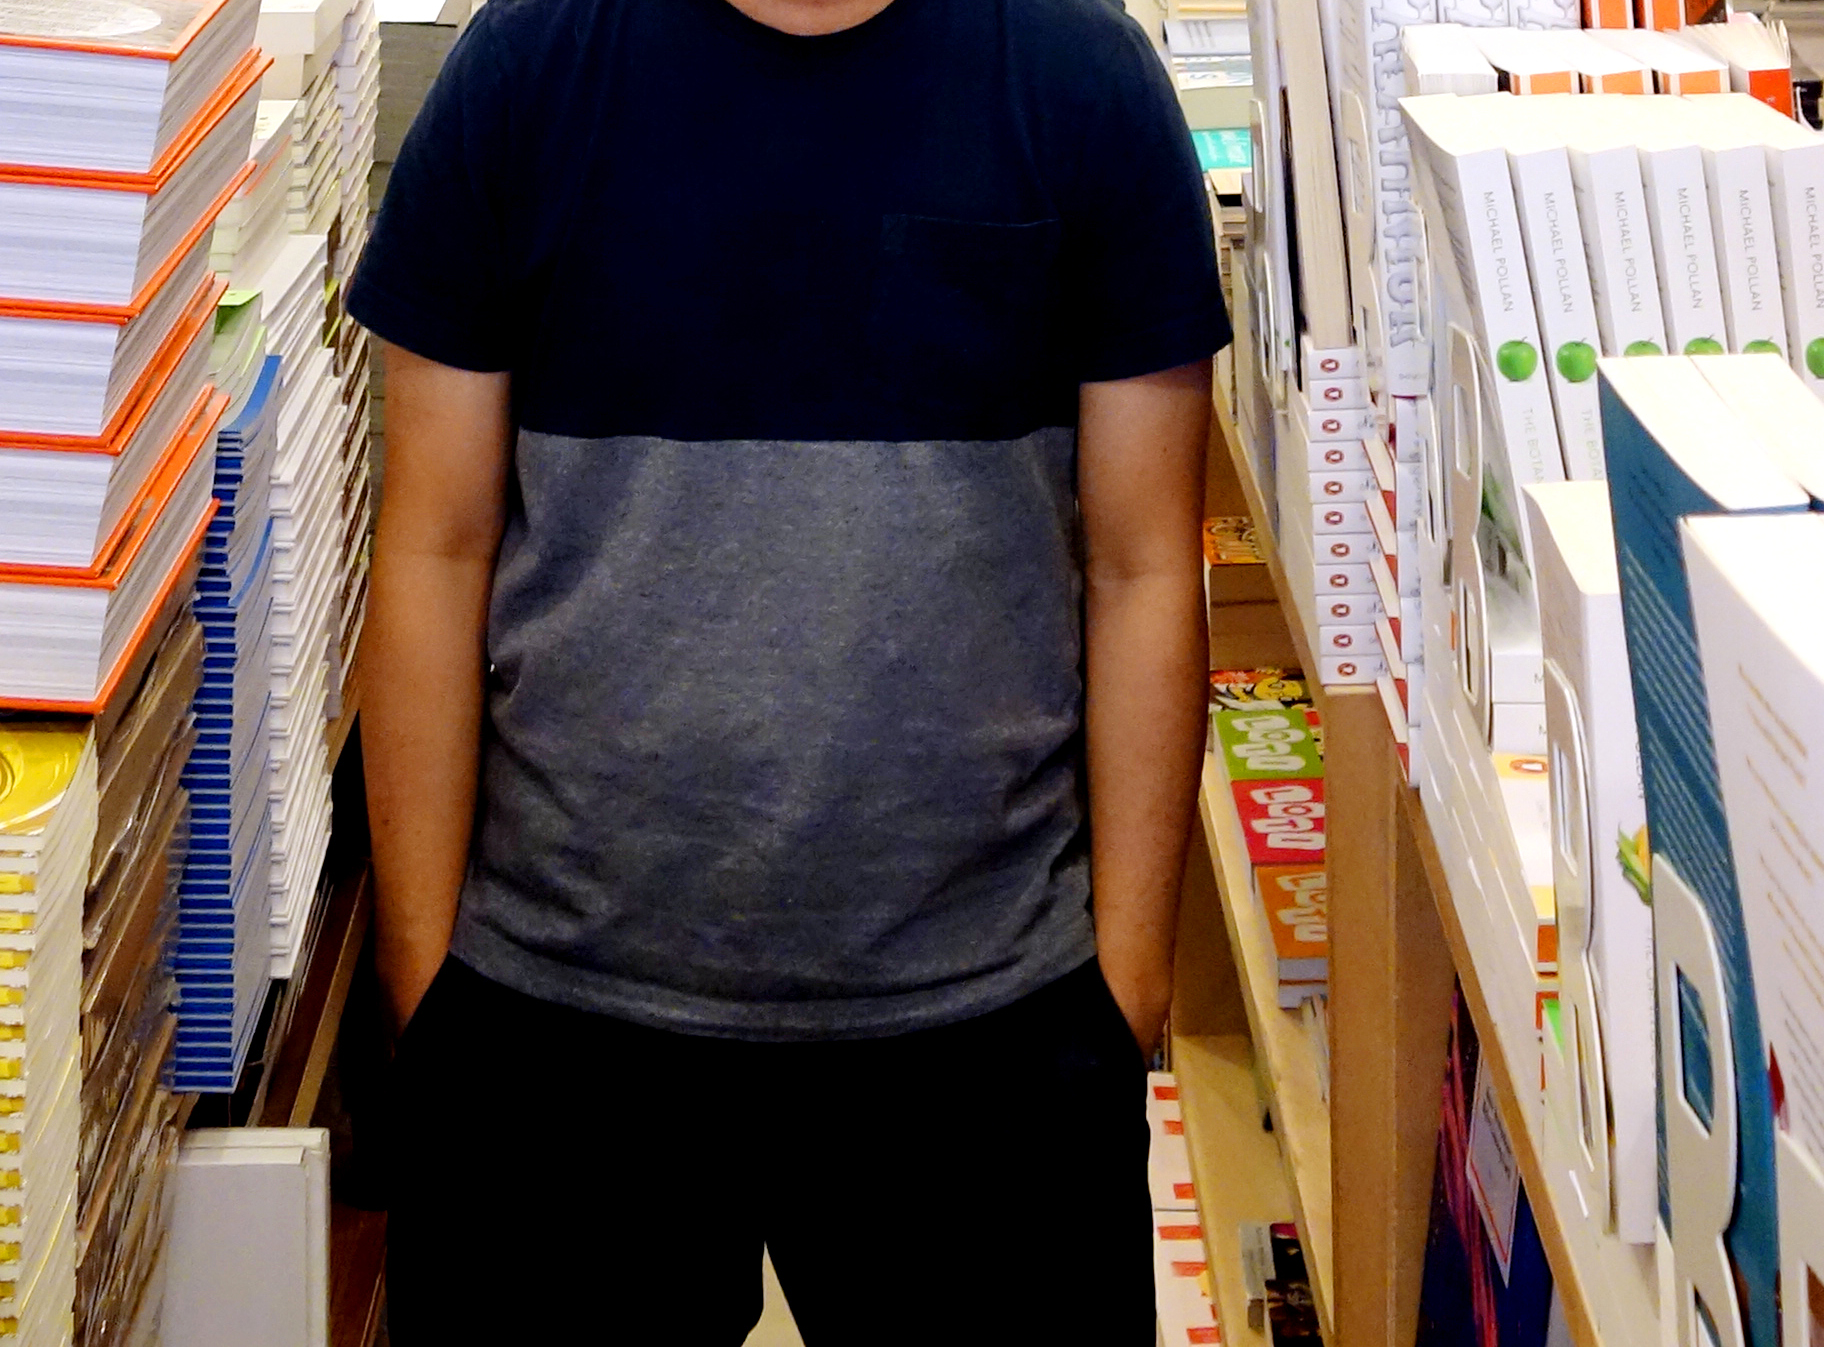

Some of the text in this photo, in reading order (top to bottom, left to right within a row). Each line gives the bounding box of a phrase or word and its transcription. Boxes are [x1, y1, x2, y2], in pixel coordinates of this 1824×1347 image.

[1484, 191, 1514, 313] MICHAEL POLLAN
[1544, 192, 1574, 313] MICHAEL POLLAN
[1615, 191, 1642, 312] MICHAEL POLLAN
[1678, 187, 1703, 310] MICHAEL POLLAN
[1739, 189, 1761, 311] MICHAEL POLLAN
[1805, 187, 1819, 250] MICHAEL
[1523, 407, 1535, 440] THE
[1581, 408, 1593, 441] THE
